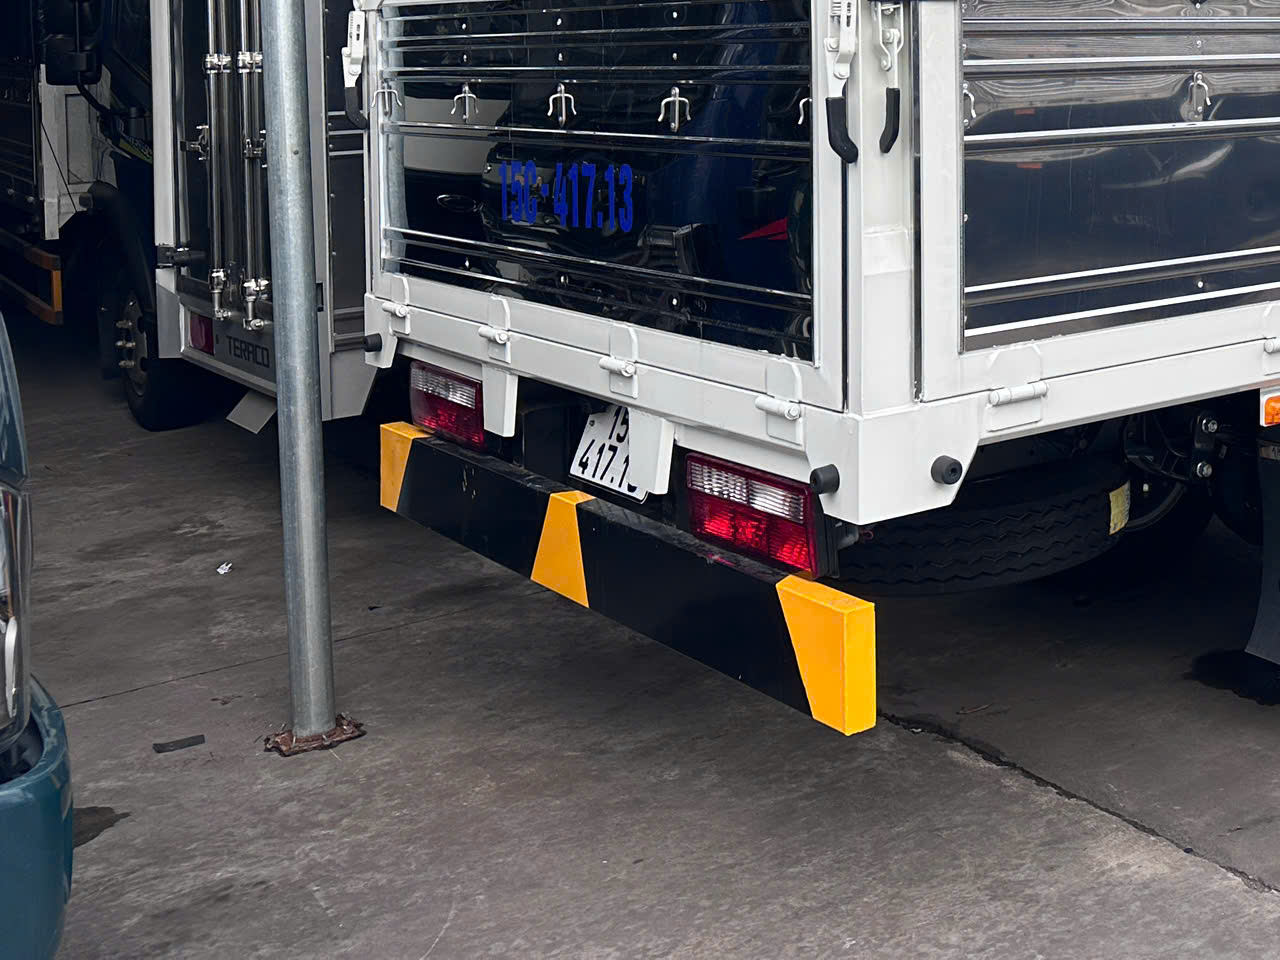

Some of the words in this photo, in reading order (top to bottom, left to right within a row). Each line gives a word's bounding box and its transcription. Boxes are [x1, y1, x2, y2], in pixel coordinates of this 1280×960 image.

[499, 159, 633, 233] 15C-417.13
[226, 335, 270, 369] TERACO
[608, 406, 630, 444] 15
[578, 439, 638, 493] 417.1
